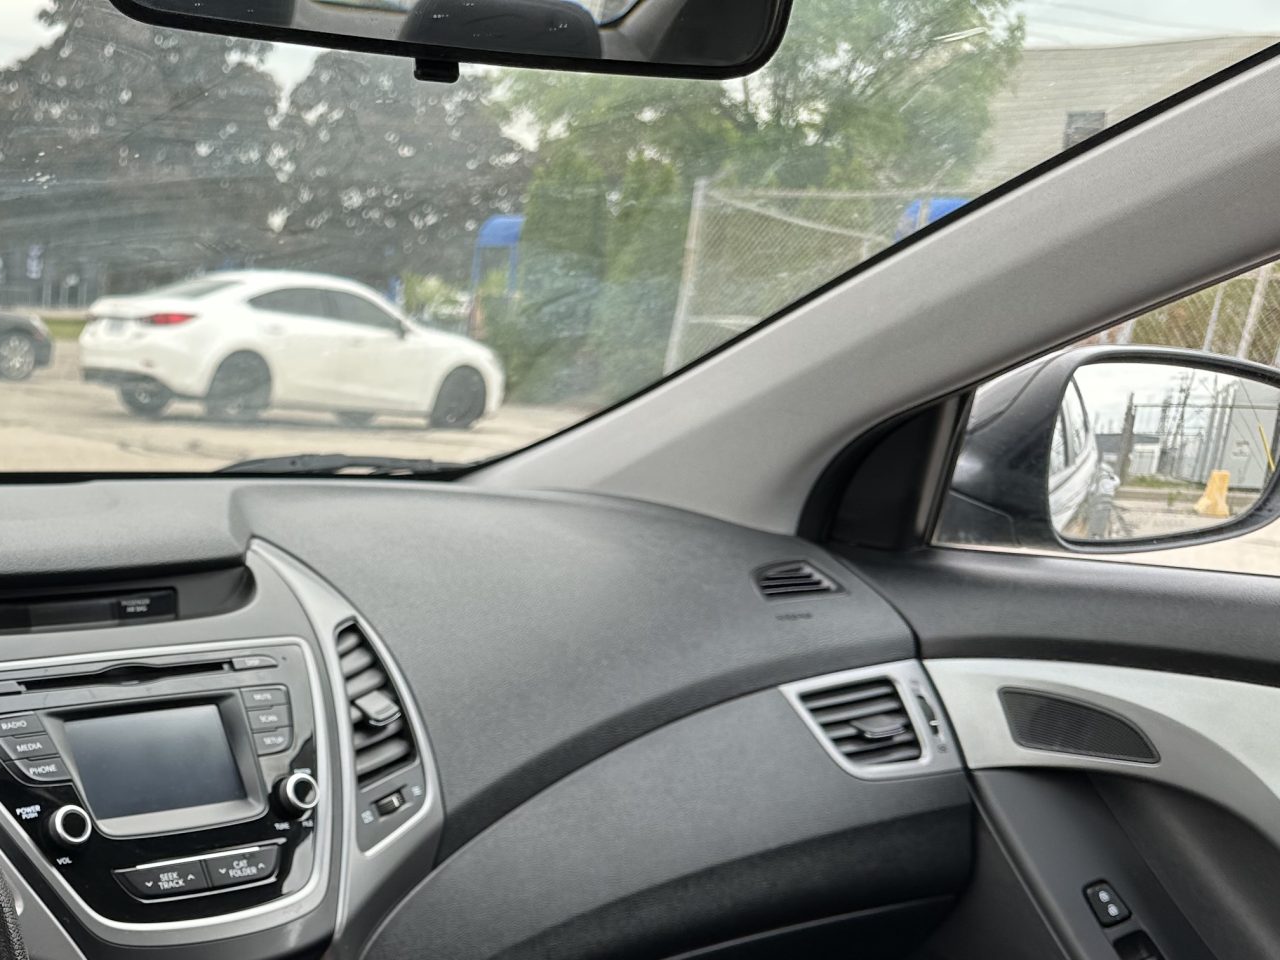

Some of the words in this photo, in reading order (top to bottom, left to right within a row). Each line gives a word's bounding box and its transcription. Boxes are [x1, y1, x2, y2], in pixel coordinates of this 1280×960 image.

[1, 719, 27, 731] RADIO
[16, 741, 43, 753] MEDIA
[29, 763, 58, 776] PHONE
[16, 804, 41, 816] POWER
[56, 856, 73, 866] VOL
[233, 859, 249, 869] CAT
[160, 871, 179, 882] SEEK
[228, 866, 258, 878] FOLDER
[158, 879, 186, 891] TRACK
